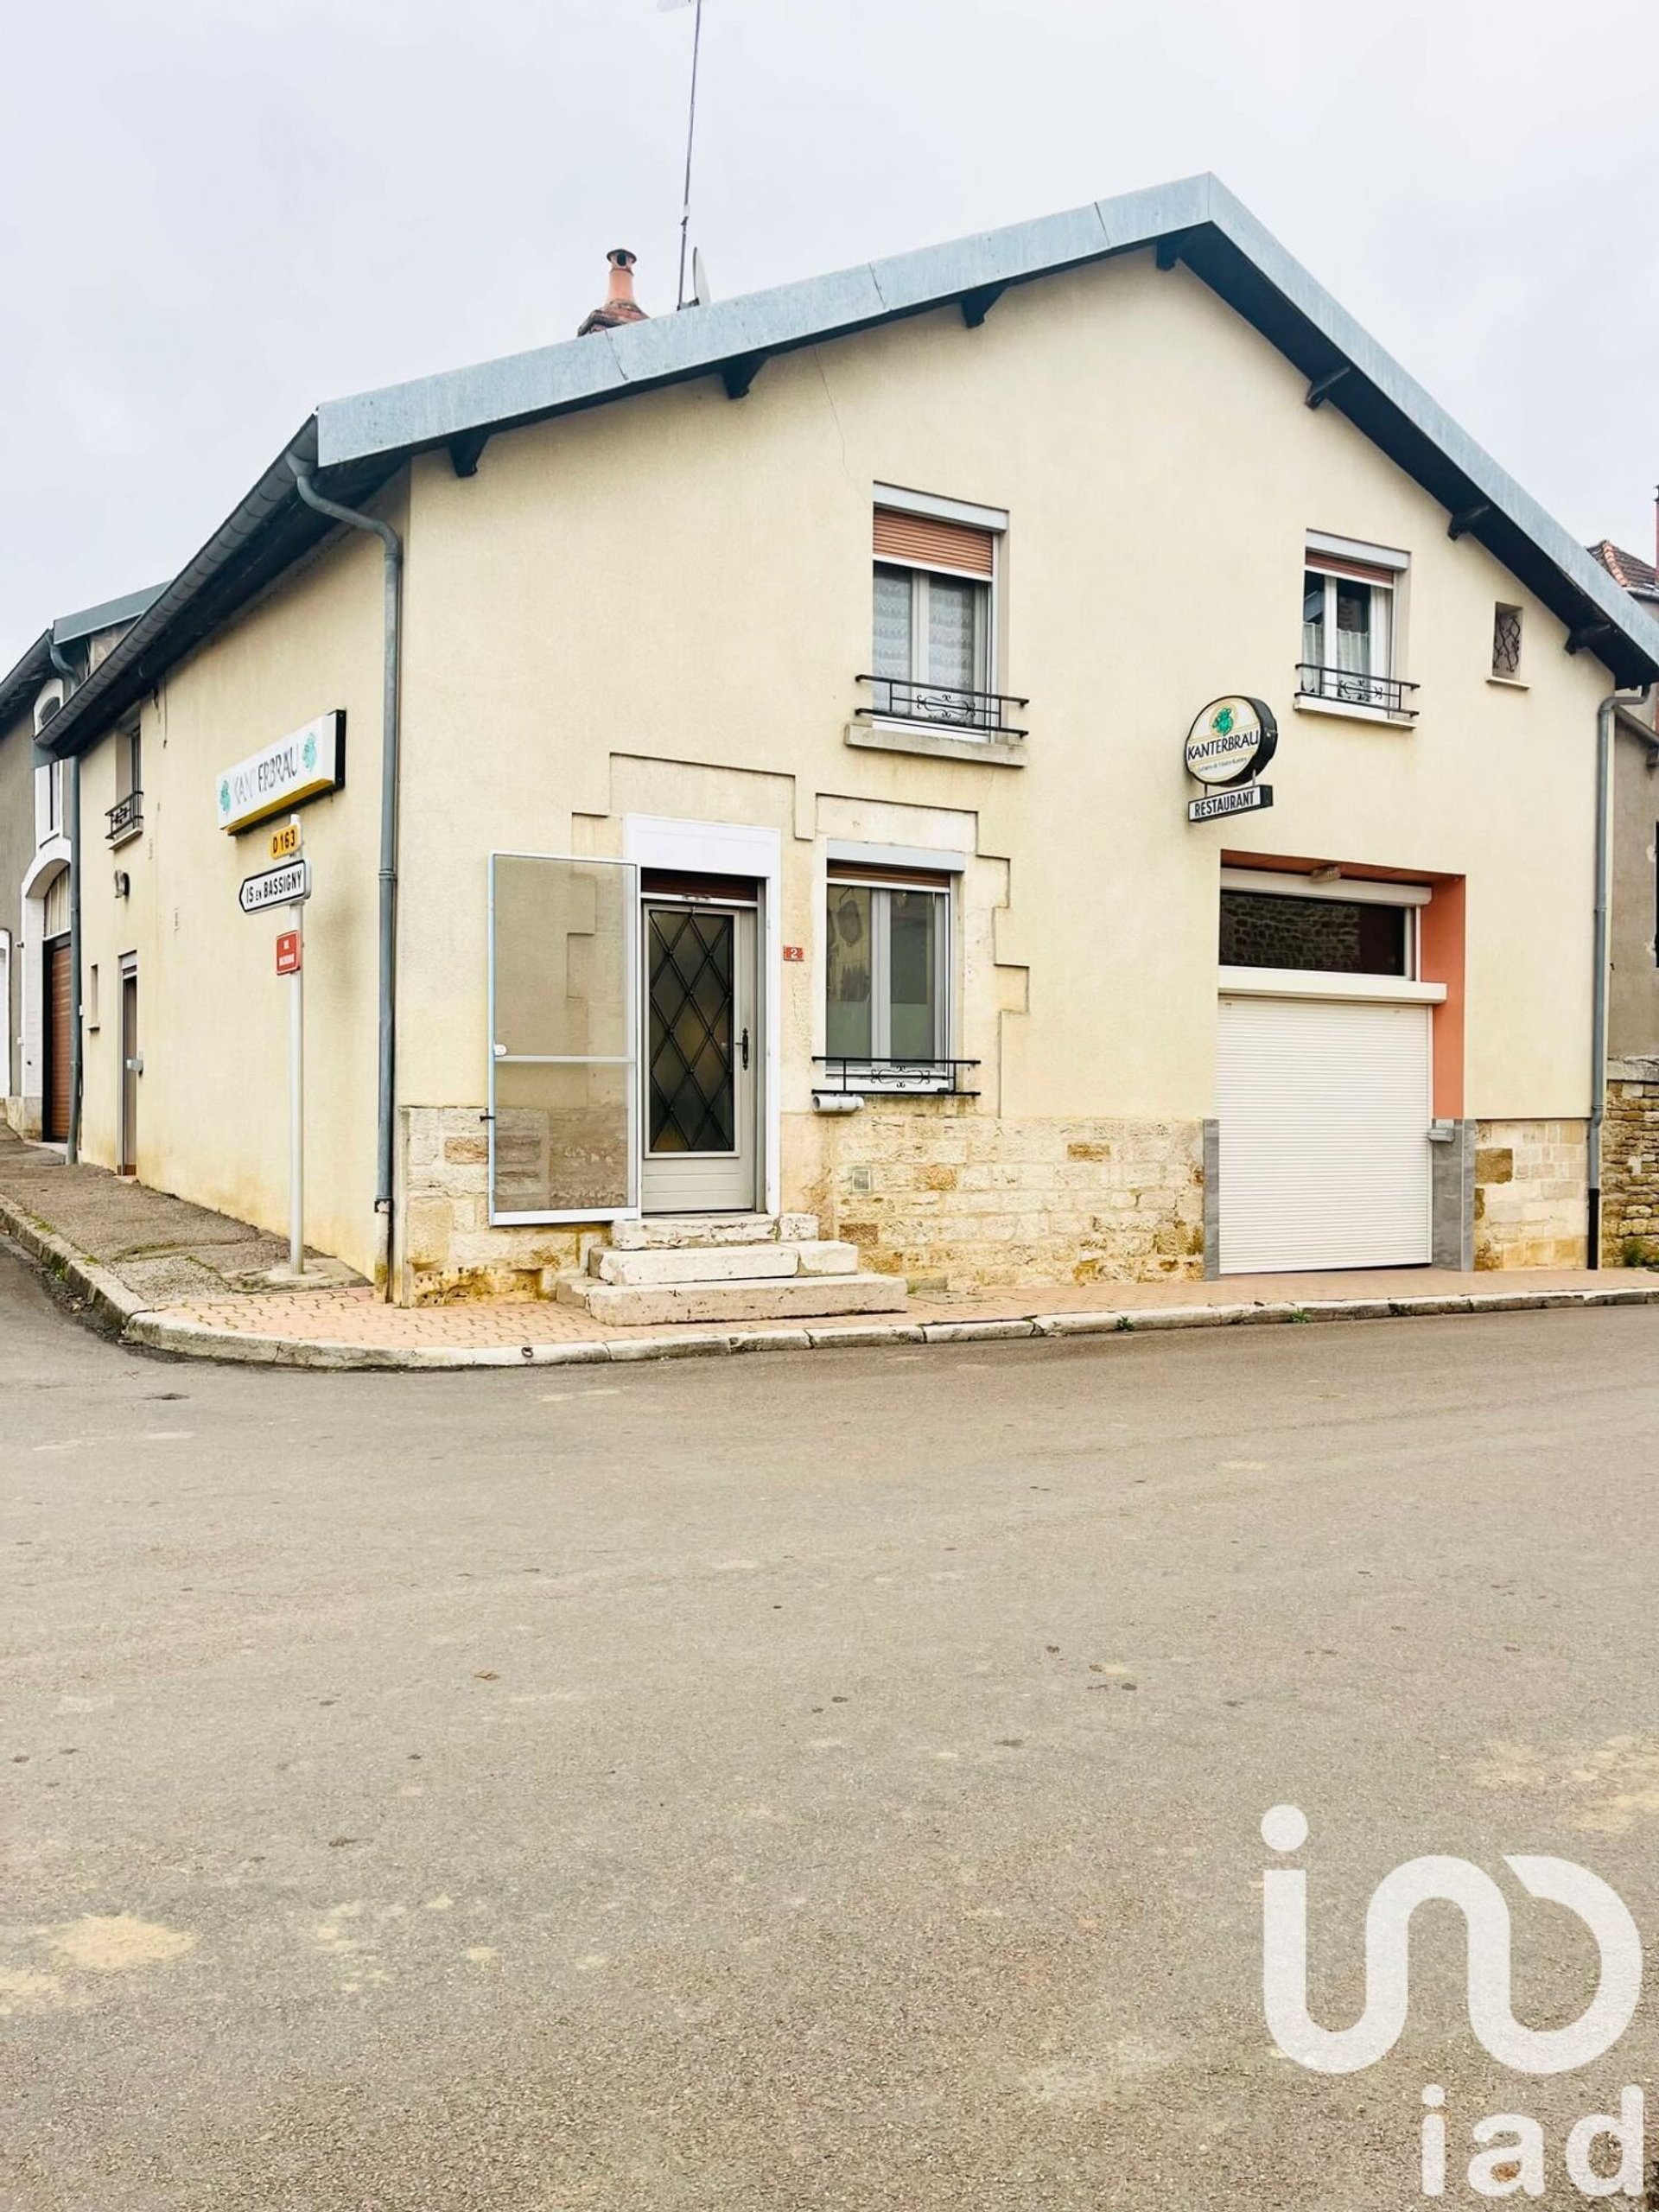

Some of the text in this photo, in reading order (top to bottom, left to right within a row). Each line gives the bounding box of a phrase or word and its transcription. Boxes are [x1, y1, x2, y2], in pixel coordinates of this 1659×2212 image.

[1194, 791, 1255, 817] RESTAURANT
[272, 829, 296, 854] D 163
[246, 885, 254, 904] IS
[264, 869, 302, 899] BASSIGNY
[790, 948, 798, 959] 2
